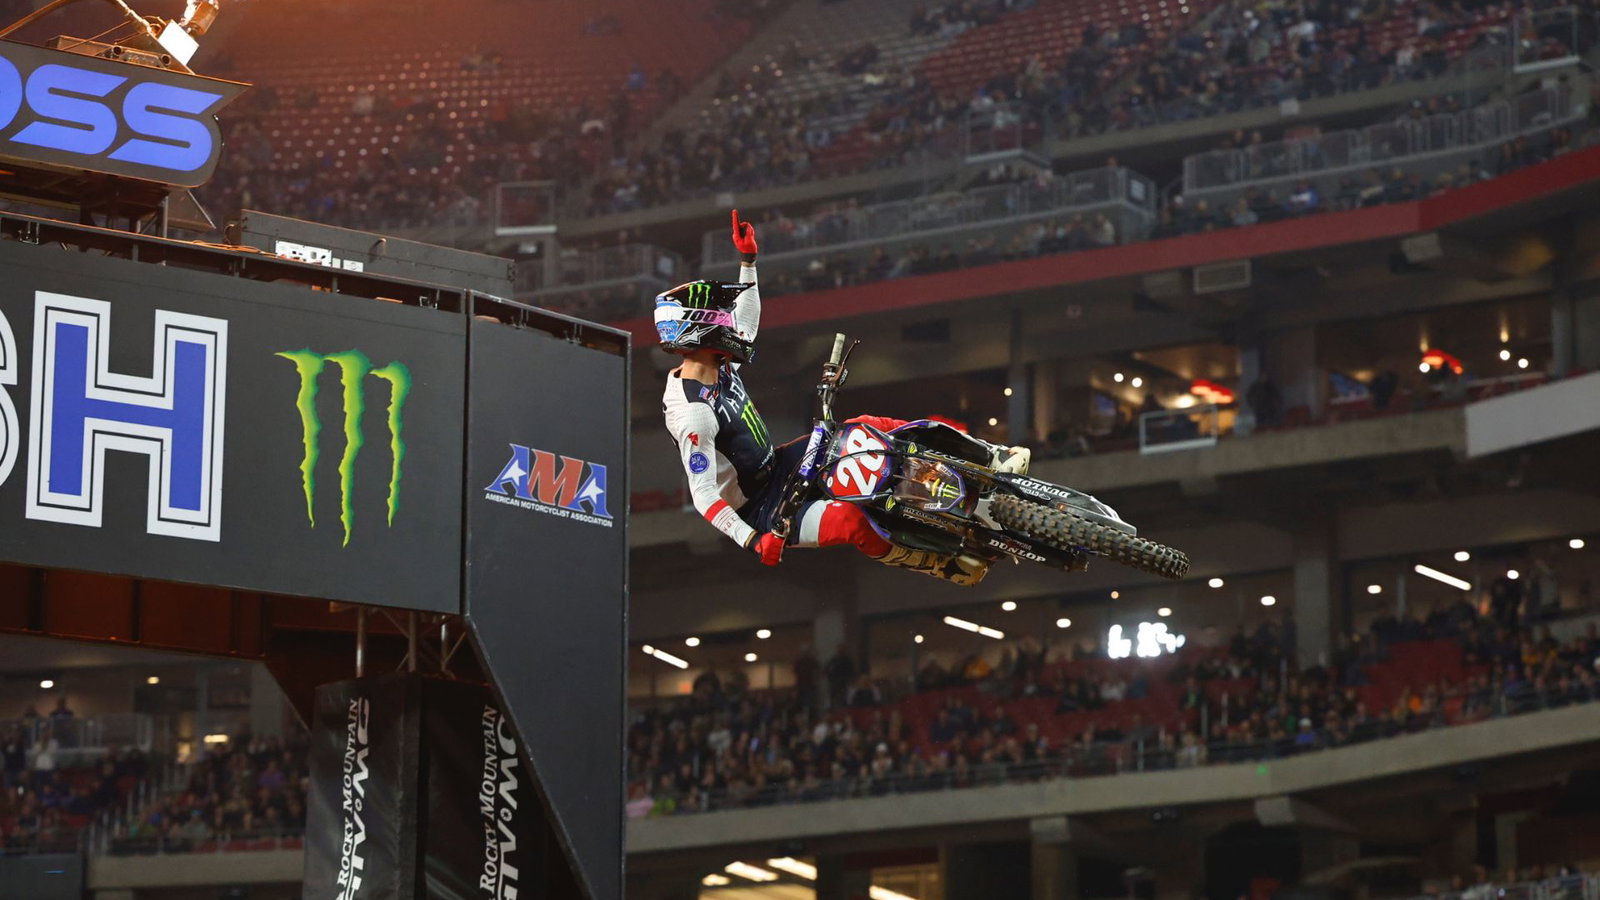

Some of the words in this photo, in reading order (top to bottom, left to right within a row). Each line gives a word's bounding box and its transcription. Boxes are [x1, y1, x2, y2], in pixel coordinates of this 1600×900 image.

[0, 54, 223, 172] SS
[0, 290, 228, 542] H
[484, 443, 614, 519] AMA
[837, 428, 885, 496] 28
[1011, 477, 1071, 499] DUNLOP
[485, 493, 520, 507] AMERICAN
[520, 501, 570, 519] MOTORCYCLIST
[570, 511, 613, 528] ASSOCIATION
[988, 539, 1046, 562] DUNLOP
[342, 699, 359, 814] MOUNTAIN
[479, 704, 498, 820] MOUNTAIN
[337, 816, 354, 888] ROCKY
[479, 822, 498, 894] ROCKY
